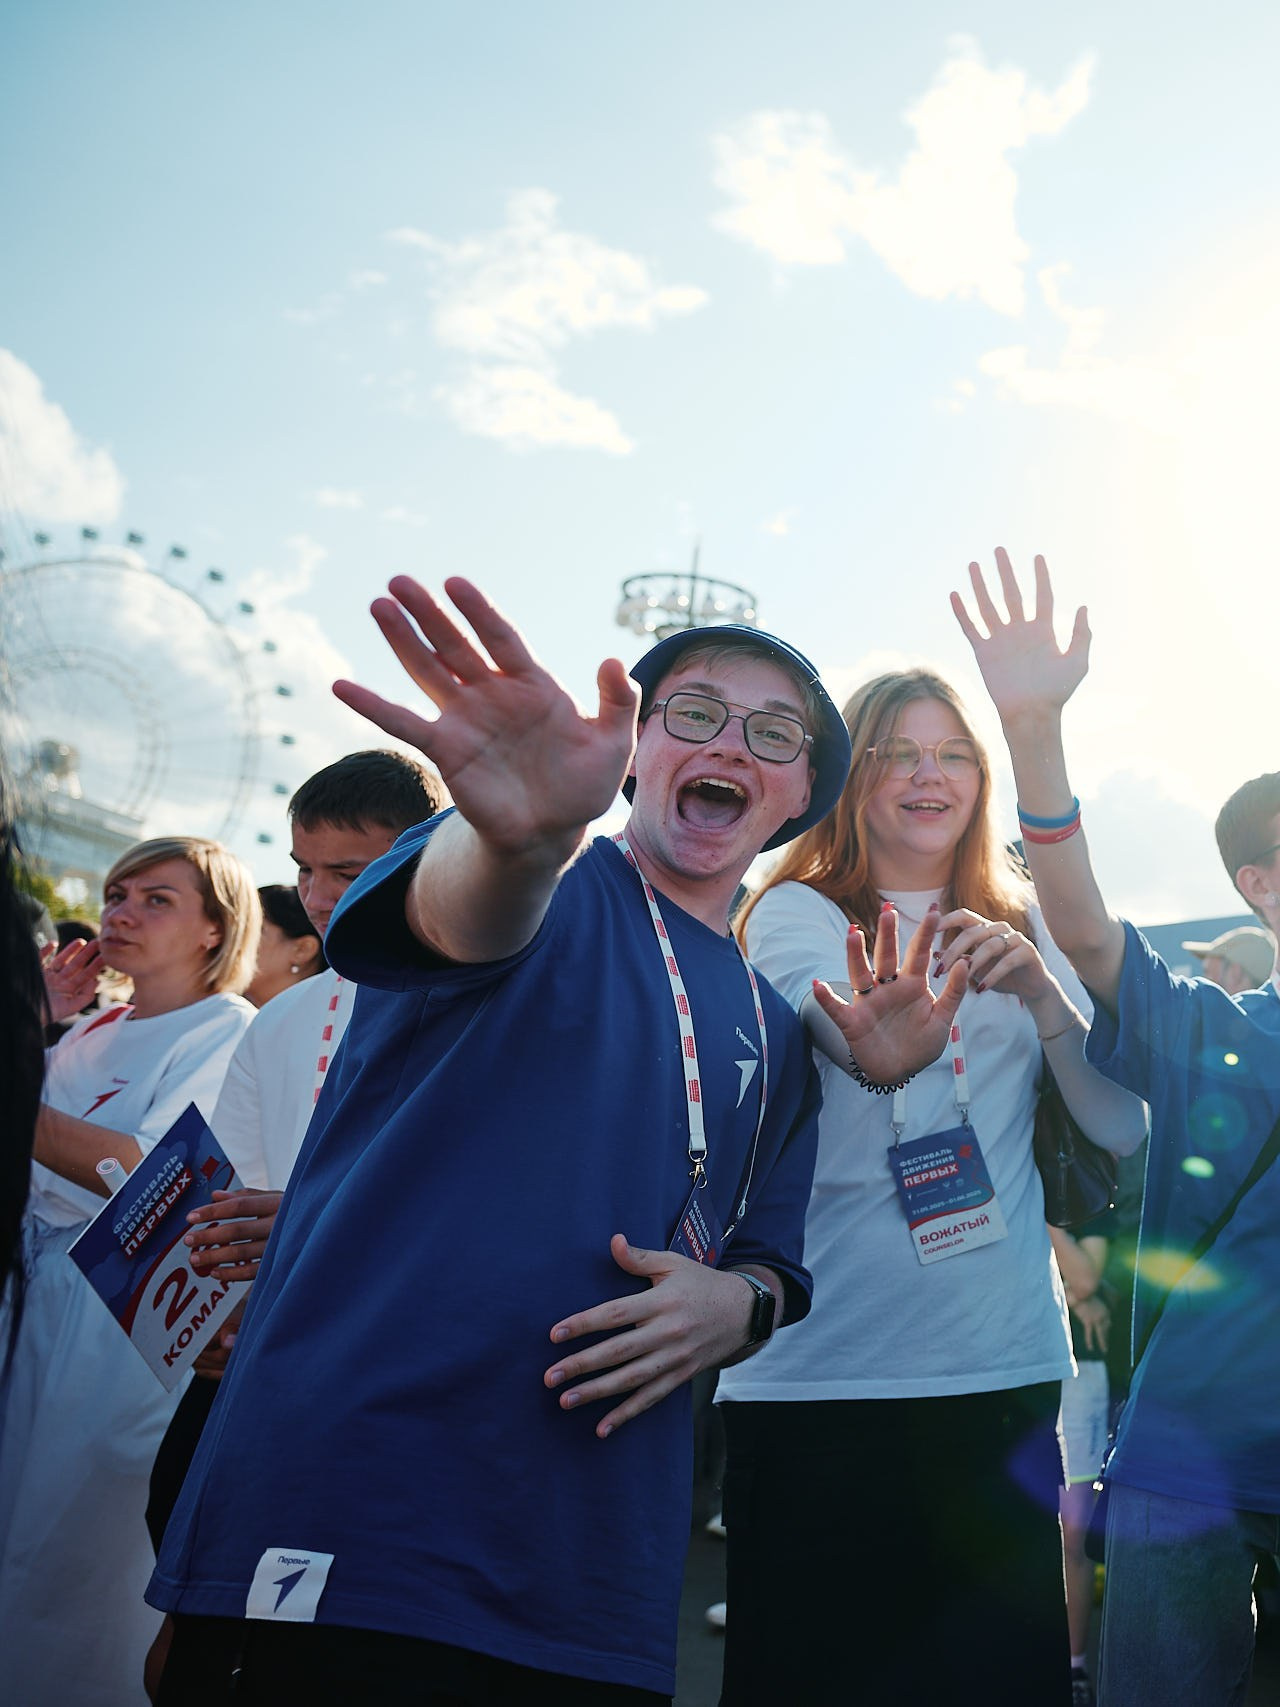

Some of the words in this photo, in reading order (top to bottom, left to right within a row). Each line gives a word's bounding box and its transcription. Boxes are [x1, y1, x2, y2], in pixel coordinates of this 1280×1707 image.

[899, 1148, 953, 1168] ФЕСТИВАЛЬ
[902, 1155, 956, 1177] ДВИЖЕНИЯ
[904, 1164, 959, 1188] ПЕРВЫХ
[113, 1155, 178, 1234] ФЕСТИВАЛЬ
[120, 1161, 184, 1245] ДВИЖЕНИЯ
[125, 1172, 191, 1256] ПЕРВЫХ
[919, 1213, 990, 1246] ВОЖАТЫЙ
[277, 1555, 311, 1566] Первые
